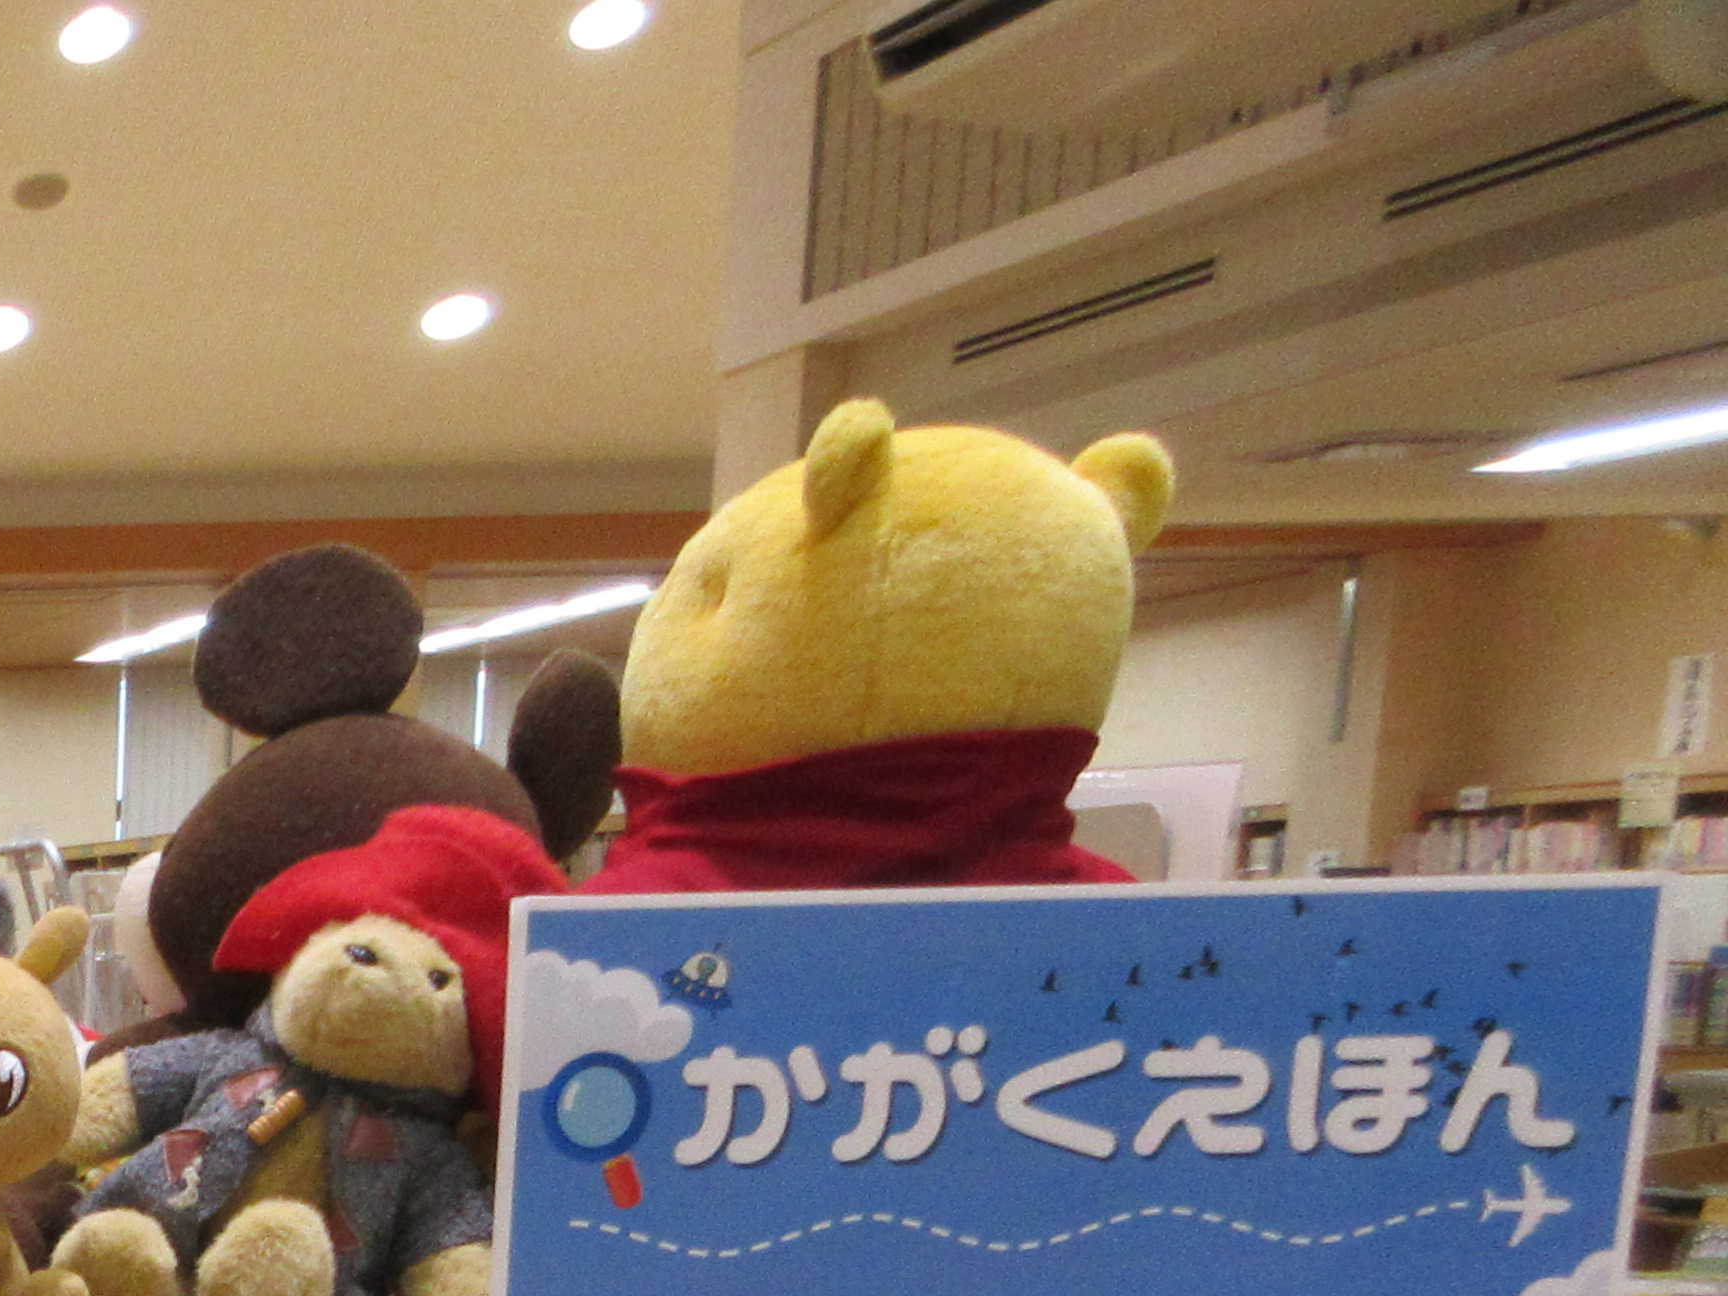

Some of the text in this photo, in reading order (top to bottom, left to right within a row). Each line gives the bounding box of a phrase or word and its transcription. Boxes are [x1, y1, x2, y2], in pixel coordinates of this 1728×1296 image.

[674, 1024, 1576, 1167] かがくえほん
